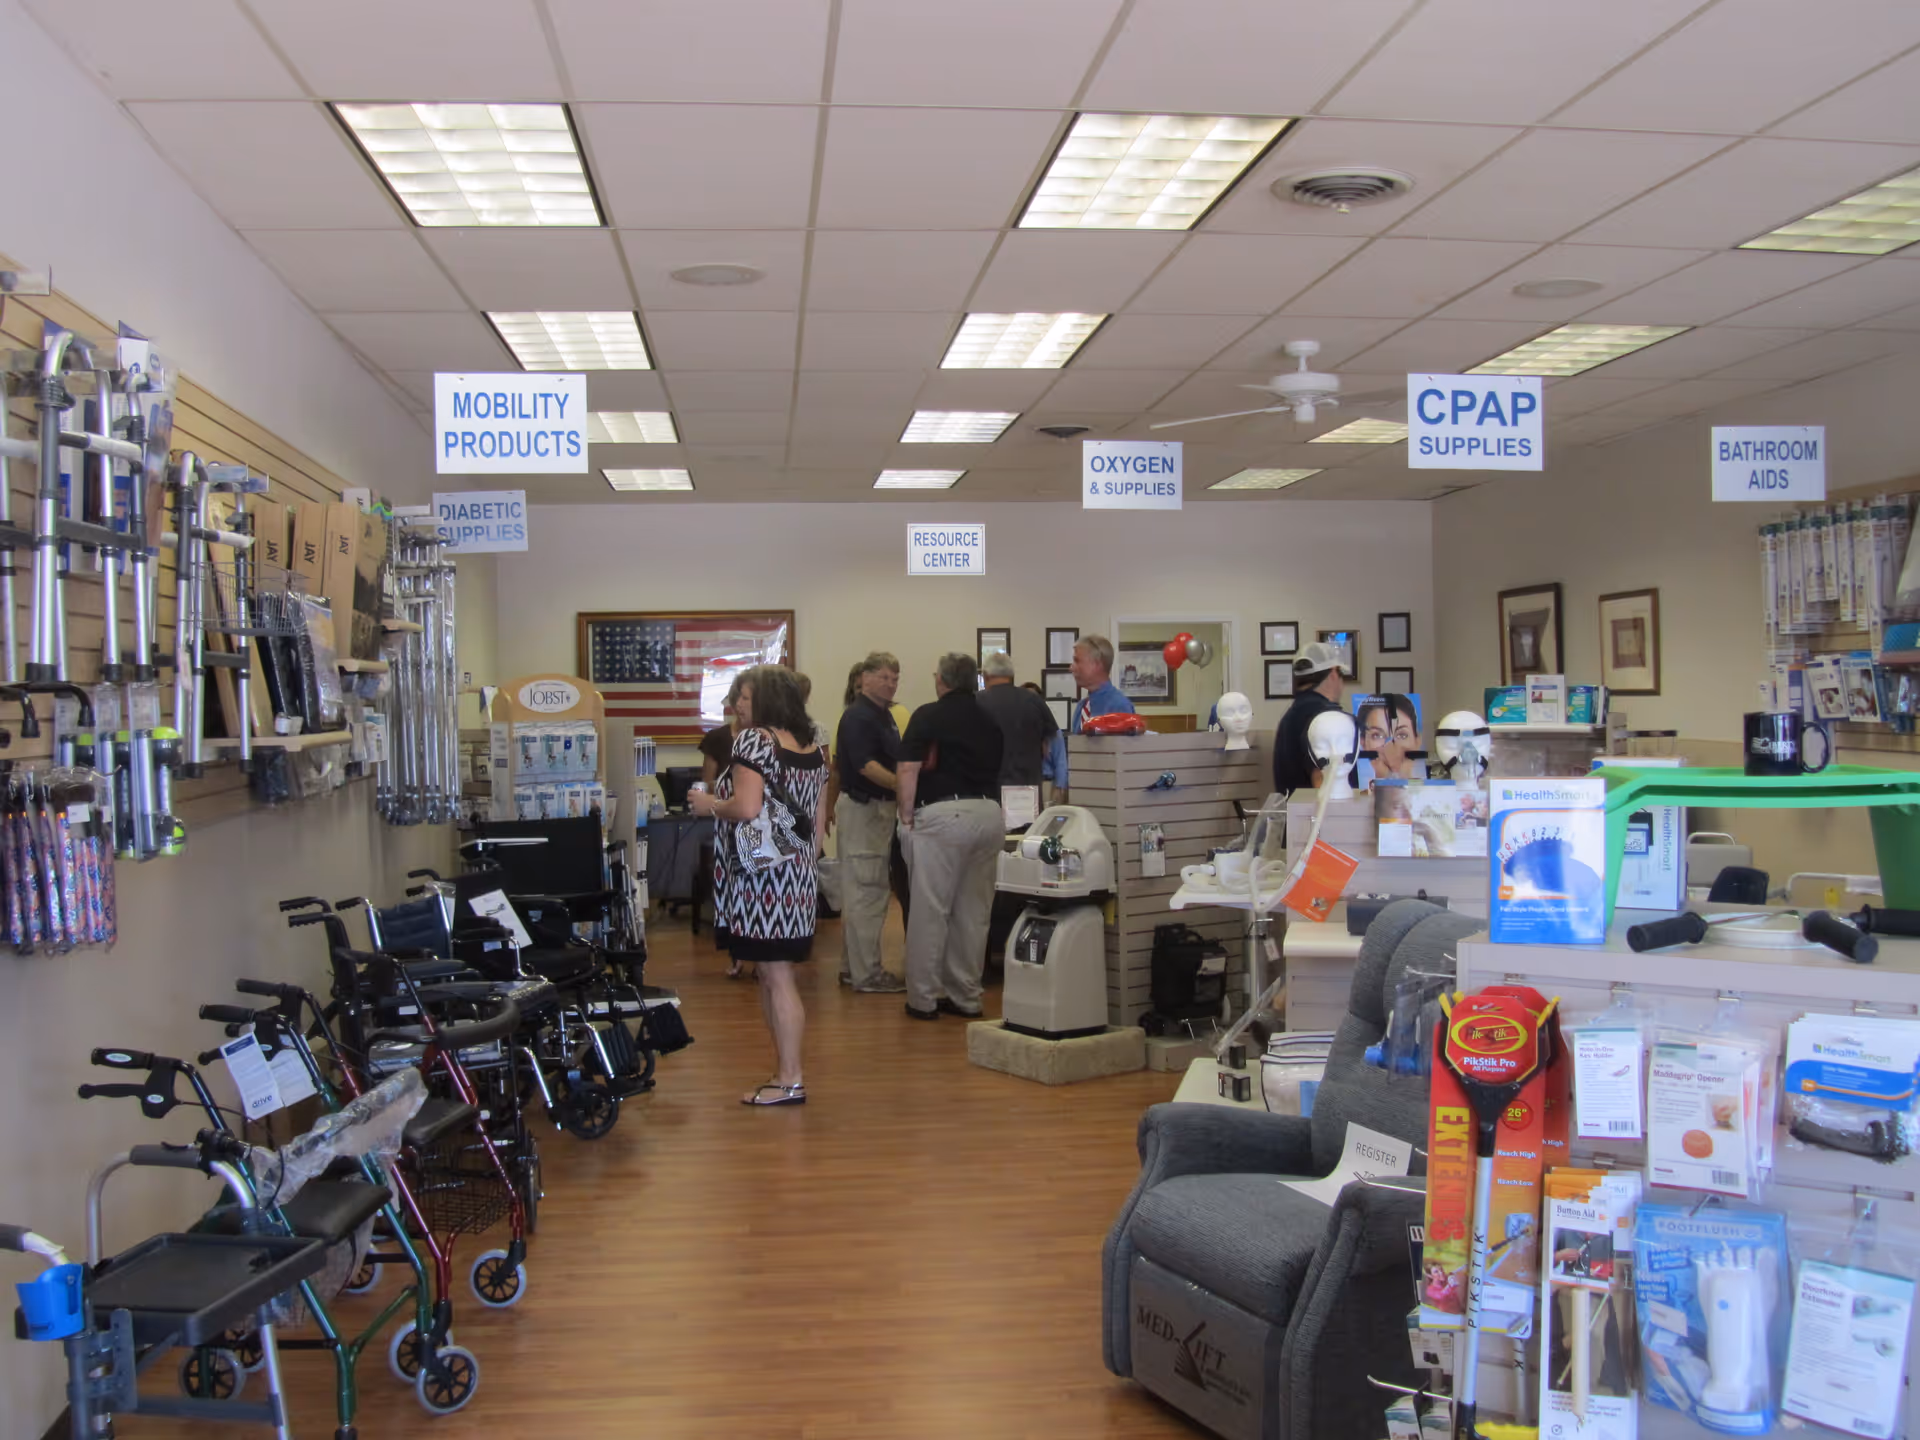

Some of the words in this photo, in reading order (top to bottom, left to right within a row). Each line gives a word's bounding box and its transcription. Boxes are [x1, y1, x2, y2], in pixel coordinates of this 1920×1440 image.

[453, 392, 569, 419] MOBILITY
[1417, 388, 1536, 427] CPAP
[444, 430, 581, 458] PRODUCTS
[1419, 436, 1532, 457] SUPPLIES
[1719, 440, 1817, 461] BATHROOM
[1090, 456, 1174, 474] OXYGEN
[1089, 482, 1100, 495] &
[1104, 482, 1176, 496] SUPPLIES
[1748, 468, 1789, 490] AIDS
[438, 502, 521, 523] DIABETIC
[437, 524, 524, 543] SUPPLIES
[914, 532, 979, 547] RESOURCE
[266, 540, 279, 563] JAY
[303, 540, 316, 565] JAY
[338, 534, 349, 556] JAY
[923, 552, 970, 568] CENTER
[529, 688, 566, 708] JOBST
[1464, 1057, 1497, 1067] PikStik
[1499, 1058, 1516, 1068] Pro
[1355, 1142, 1397, 1168] REGISTER
[1429, 1106, 1470, 1241] EXTENDS
[1556, 1205, 1581, 1217] Button
[1582, 1208, 1596, 1219] Aid
[1467, 1232, 1485, 1329] PIKSTIK
